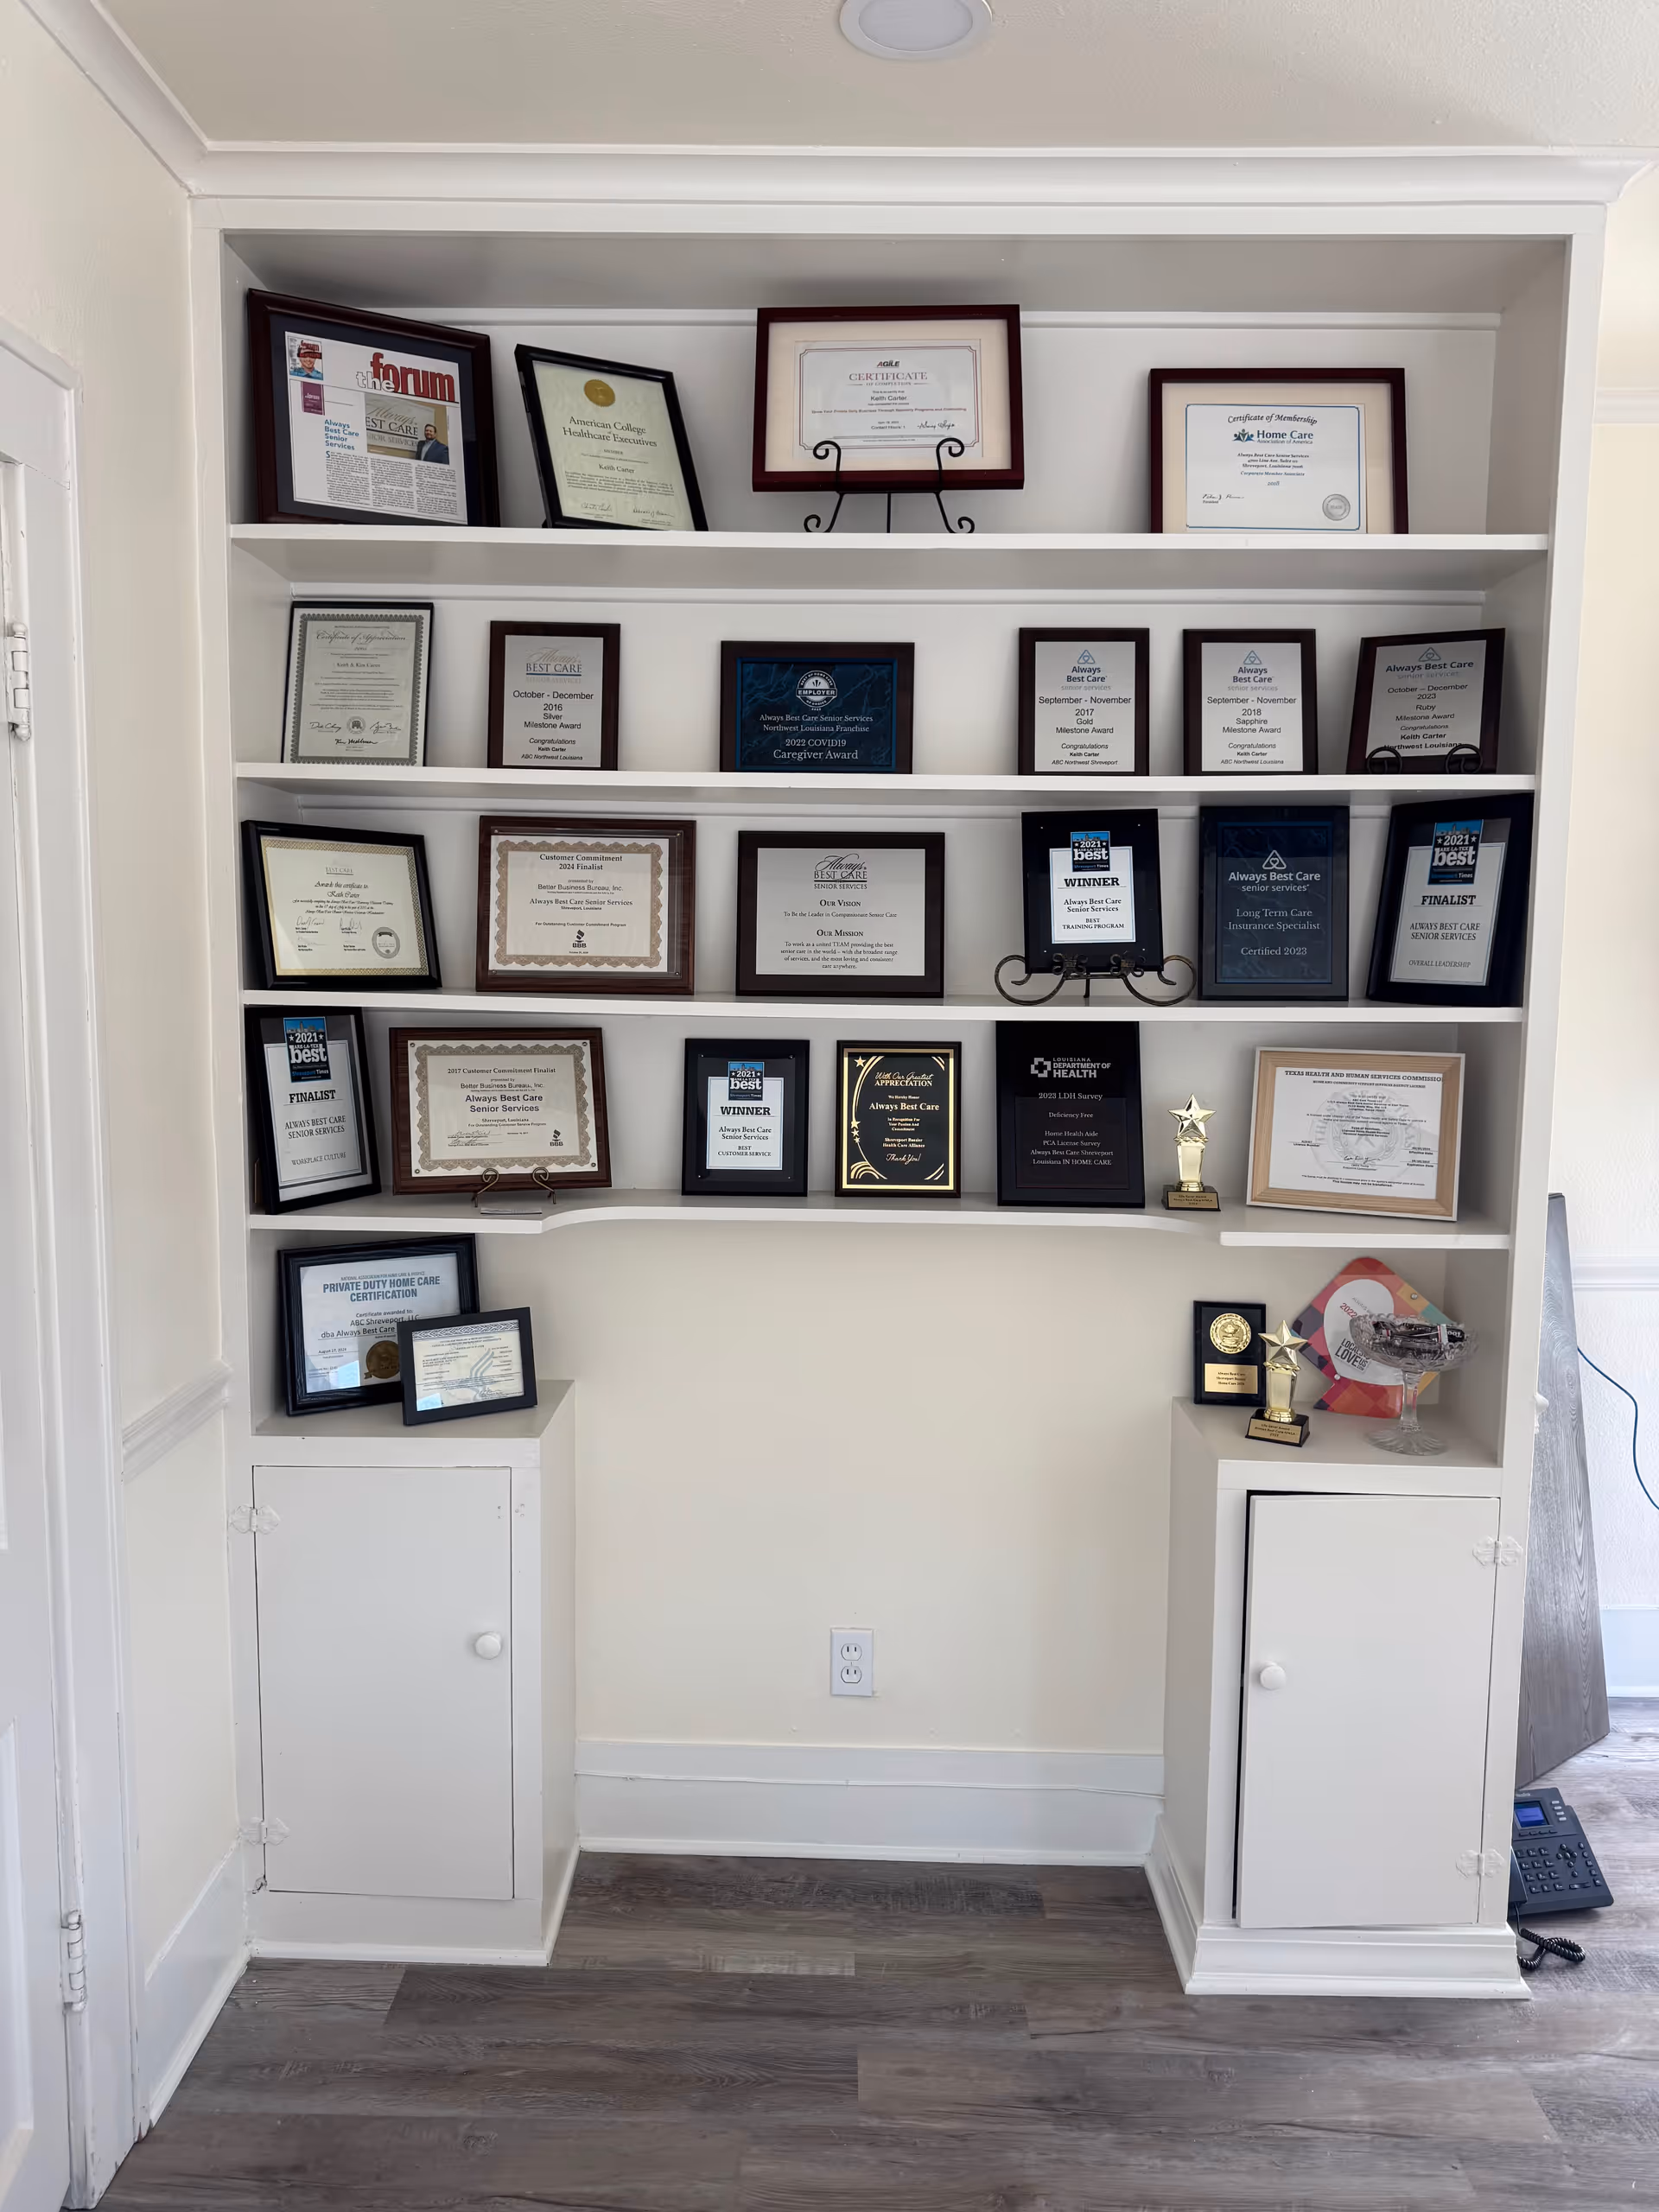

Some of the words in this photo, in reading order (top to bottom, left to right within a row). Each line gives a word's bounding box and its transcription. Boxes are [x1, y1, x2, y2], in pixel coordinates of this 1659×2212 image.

[356, 372, 395, 392] the
[371, 353, 455, 402] forum
[849, 372, 928, 381] CERTIFICATE
[325, 419, 350, 429] Always
[1228, 414, 1264, 423] Certificate
[1274, 414, 1318, 425] Membership
[569, 416, 611, 429] American
[613, 422, 646, 435] College
[325, 433, 347, 442] Senior
[563, 427, 611, 442] Healthcare
[613, 434, 658, 447] Executives
[1257, 430, 1287, 439] Home
[1290, 430, 1313, 440] Care
[325, 440, 355, 450] Services
[316, 631, 350, 644] Certificate
[359, 632, 405, 644] Appreciation
[526, 664, 550, 672] BEST
[554, 664, 582, 673] CARE
[1071, 666, 1101, 675] Always
[553, 691, 594, 700] December
[1039, 696, 1082, 705] September
[1207, 696, 1249, 705] September
[773, 750, 823, 761] Caregiver
[825, 750, 858, 760] Award
[1443, 835, 1469, 846] 2021
[1073, 849, 1109, 861] best
[1432, 847, 1476, 866] best
[814, 870, 837, 879] BEST
[841, 871, 868, 880] CARE
[1228, 872, 1267, 883] Always
[1270, 872, 1294, 880] Best
[1296, 872, 1321, 880] Care
[1064, 878, 1120, 887] WINNER
[1421, 895, 1477, 906] FINALIST
[1236, 909, 1261, 918] Long
[1276, 921, 1320, 931] Specialist
[289, 1090, 336, 1103] FINALIST
[465, 1094, 498, 1103] Always
[720, 1106, 771, 1116] WINNER
[869, 1103, 898, 1111] Always
[291, 1155, 324, 1166] WORKPLACE
[324, 1152, 346, 1160] CULTURE
[905, 1154, 922, 1165] You!
[323, 1281, 361, 1293] PRIVATE
[363, 1280, 387, 1289] DUTY
[389, 1278, 416, 1287] HOME
[417, 1276, 440, 1286] CARE
[350, 1288, 417, 1302] CERTIFICATION
[1340, 1302, 1358, 1318] 2022
[321, 1330, 334, 1338] dba
[1335, 1346, 1360, 1366] LOVE
